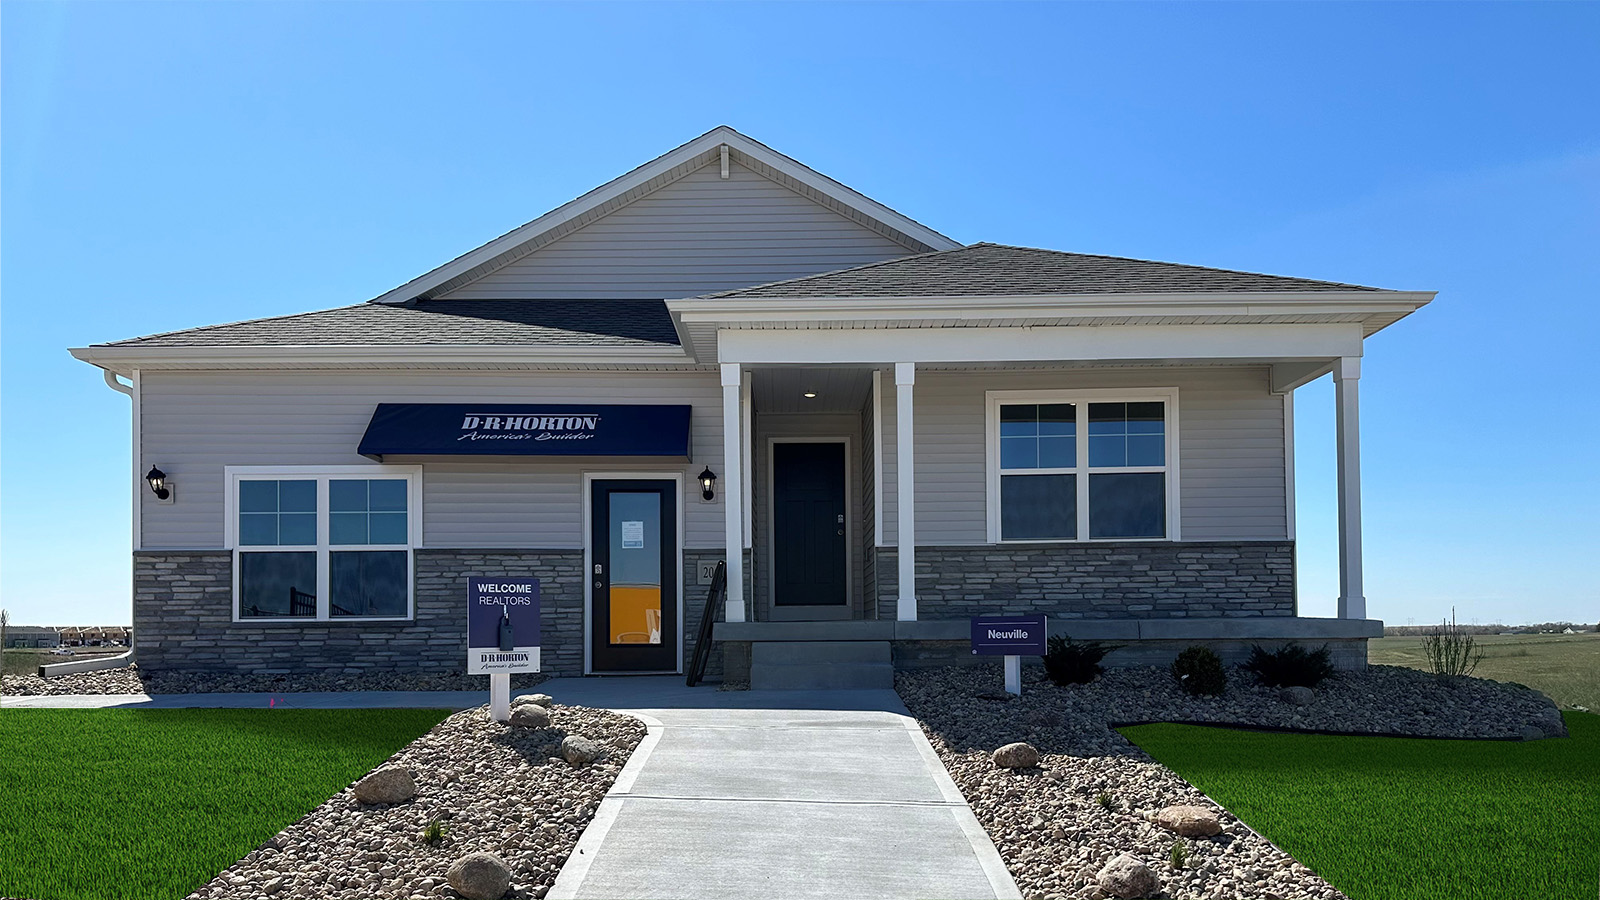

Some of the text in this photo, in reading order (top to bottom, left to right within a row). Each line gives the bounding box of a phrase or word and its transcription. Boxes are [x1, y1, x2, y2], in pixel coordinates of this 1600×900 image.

[457, 431, 595, 441] America's Builder
[703, 566, 715, 578] 20
[477, 583, 532, 593] WELCOME
[479, 596, 531, 606] REALTORS
[988, 629, 1028, 639] Neuville
